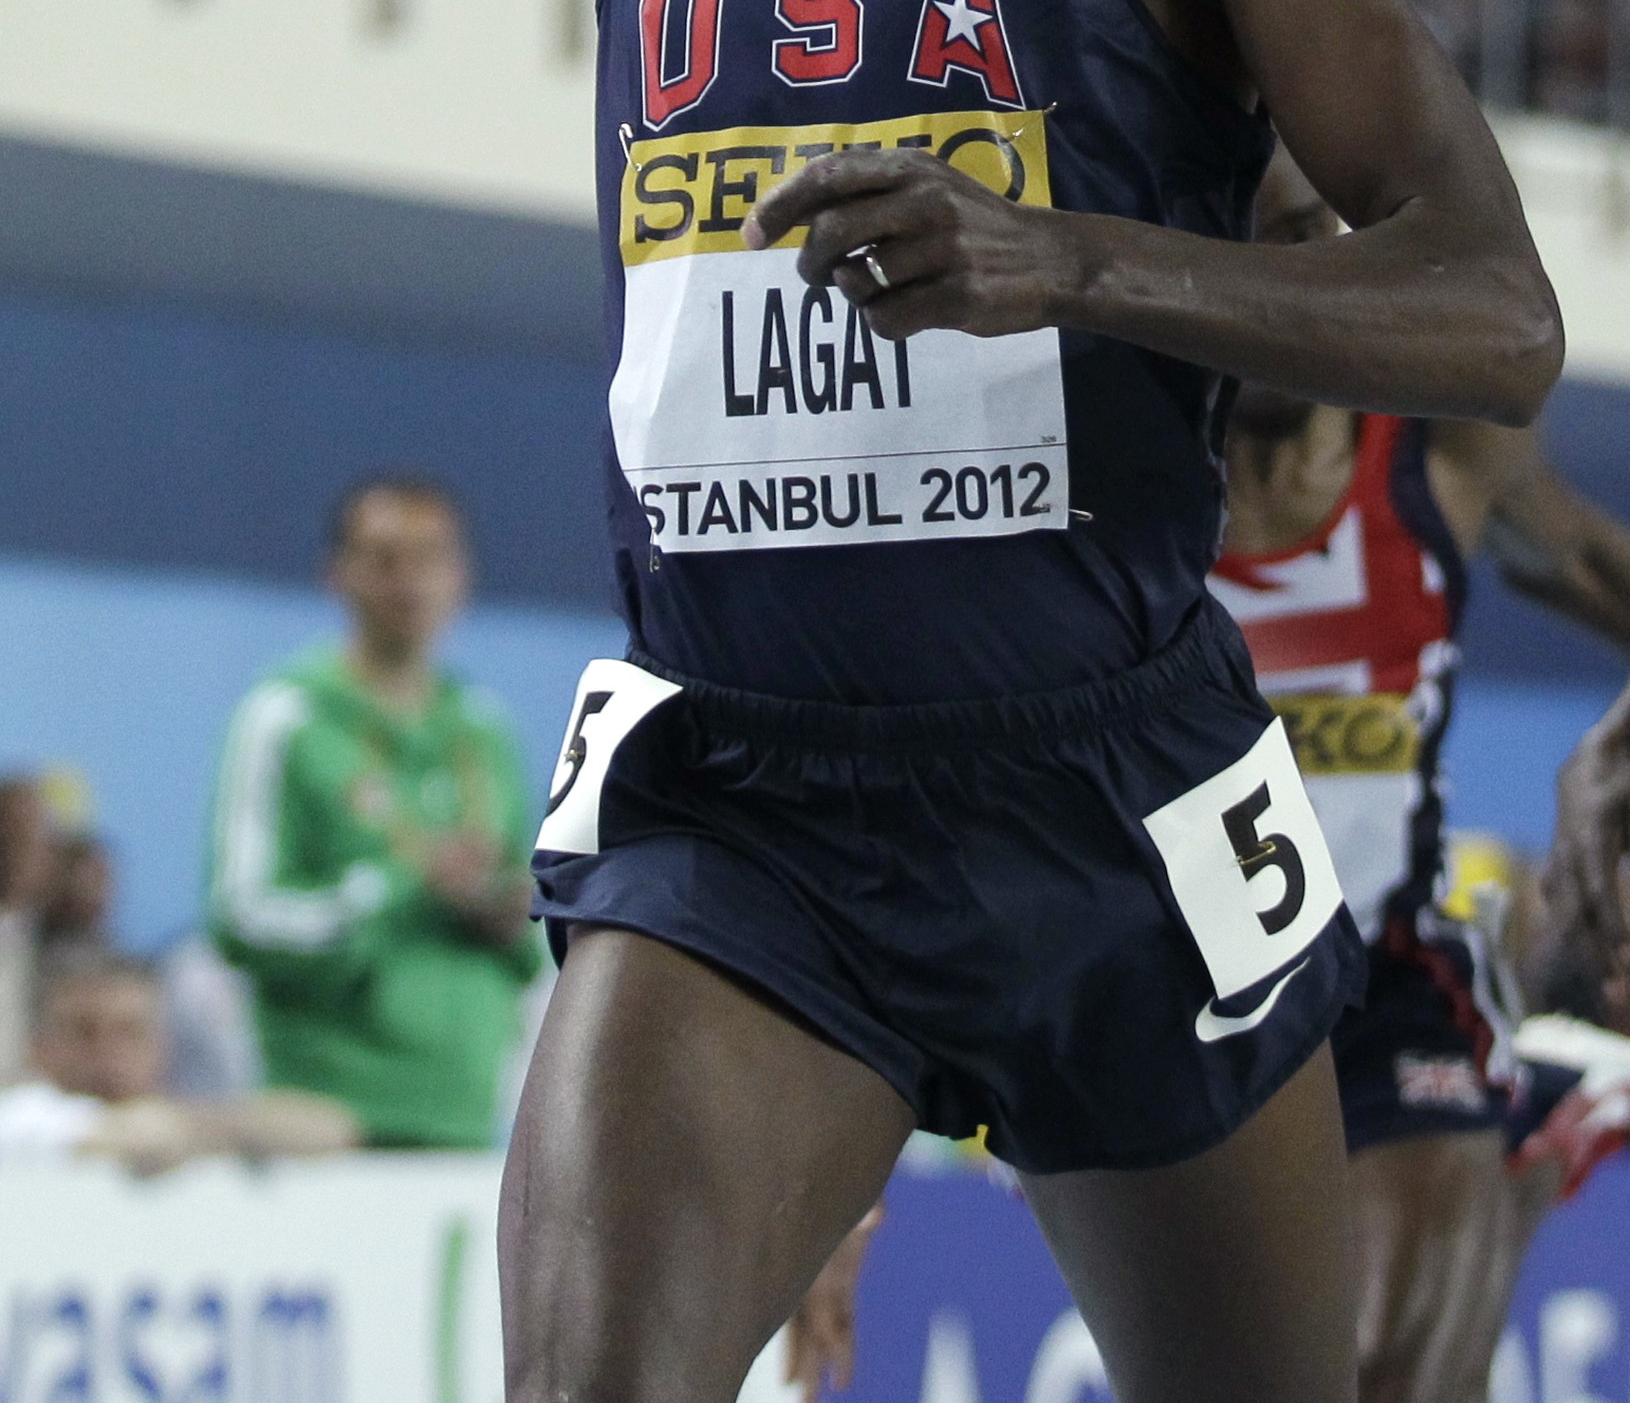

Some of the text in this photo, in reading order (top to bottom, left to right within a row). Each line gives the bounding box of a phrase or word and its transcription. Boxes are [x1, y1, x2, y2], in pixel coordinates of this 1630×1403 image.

[634, 127, 1025, 244] SEO
[633, 462, 1052, 536] STANBUL 2012
[545, 691, 615, 819] 5
[1221, 779, 1306, 936] 5
